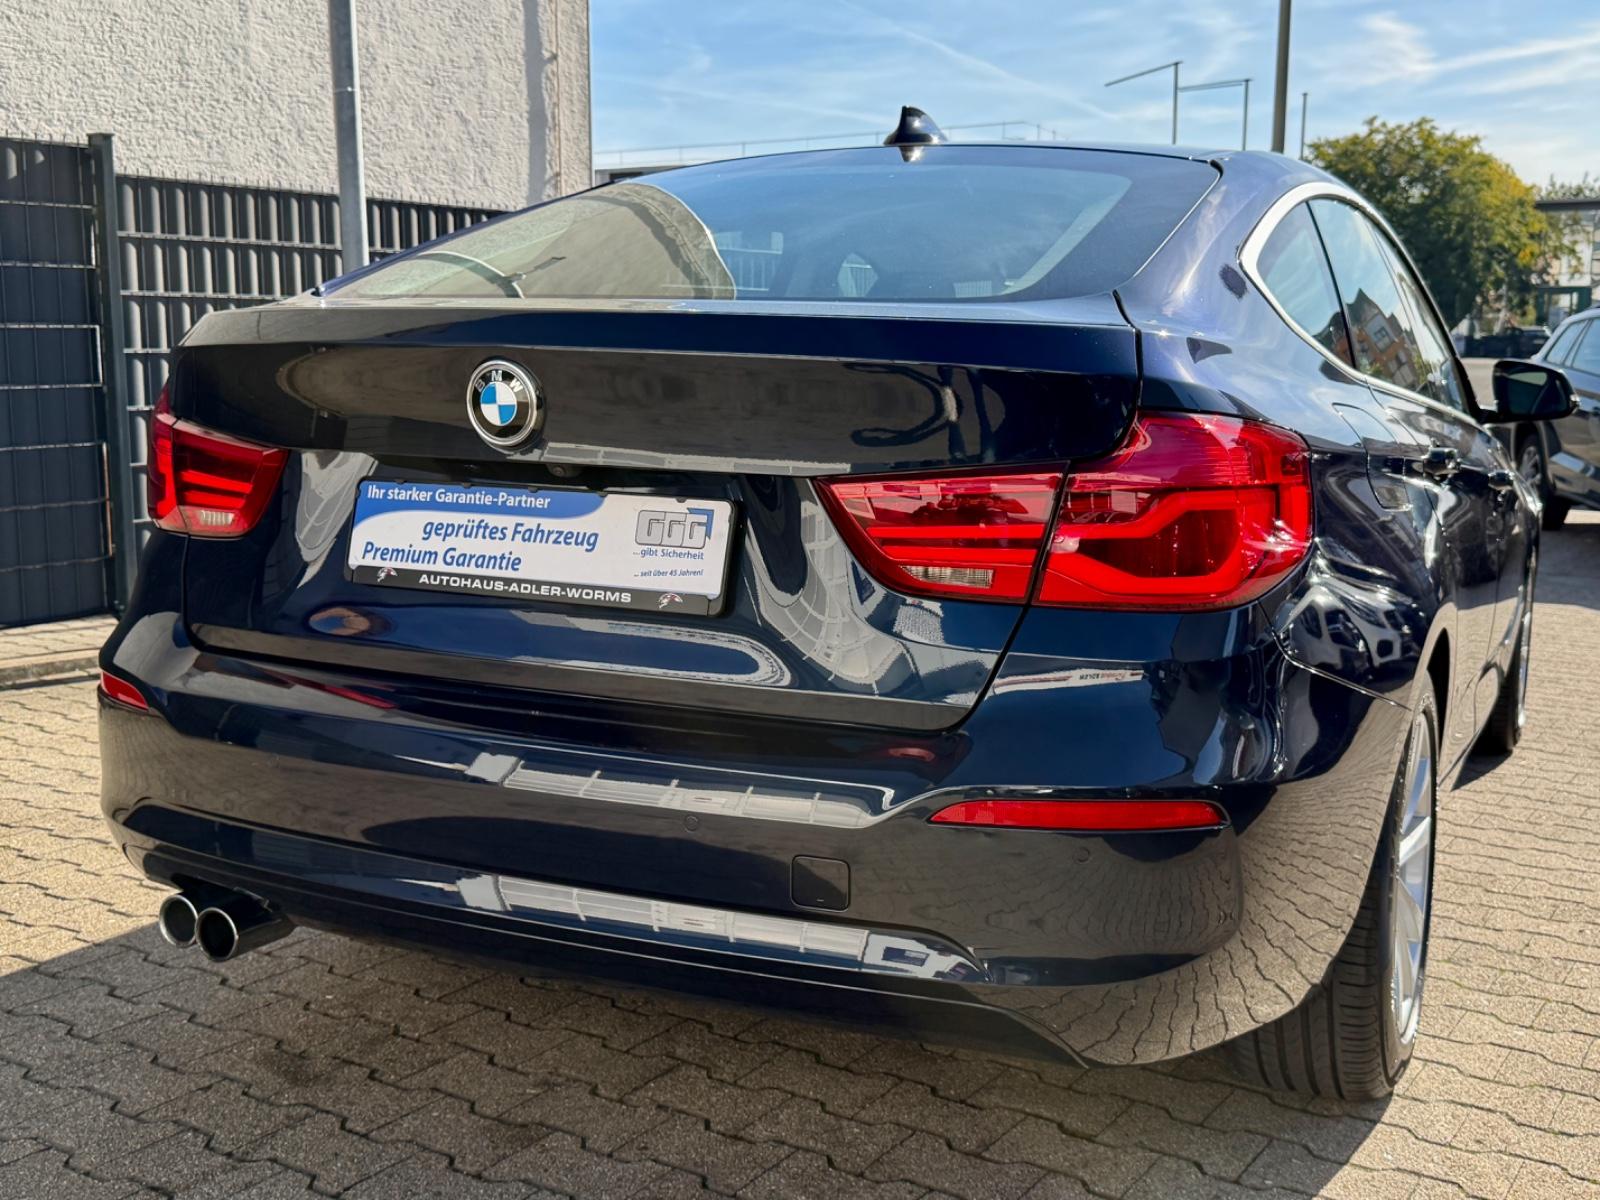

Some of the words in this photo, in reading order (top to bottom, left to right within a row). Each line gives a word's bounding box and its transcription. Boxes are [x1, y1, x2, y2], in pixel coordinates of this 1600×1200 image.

[475, 370, 524, 393] BMW
[367, 485, 387, 500] Ihr
[387, 486, 432, 503] starker
[435, 488, 551, 508] Garantie-Partner
[422, 518, 508, 542] geprüftes
[511, 522, 599, 552] Fahrzeug
[362, 541, 438, 565] Premium
[443, 547, 522, 572] Garantie
[660, 549, 704, 560] Sicherheit
[652, 569, 668, 577] über
[668, 569, 678, 577] 45
[678, 568, 704, 577] Jahren!
[418, 574, 632, 603] AUTOHAUS-ADLER-WORMS
